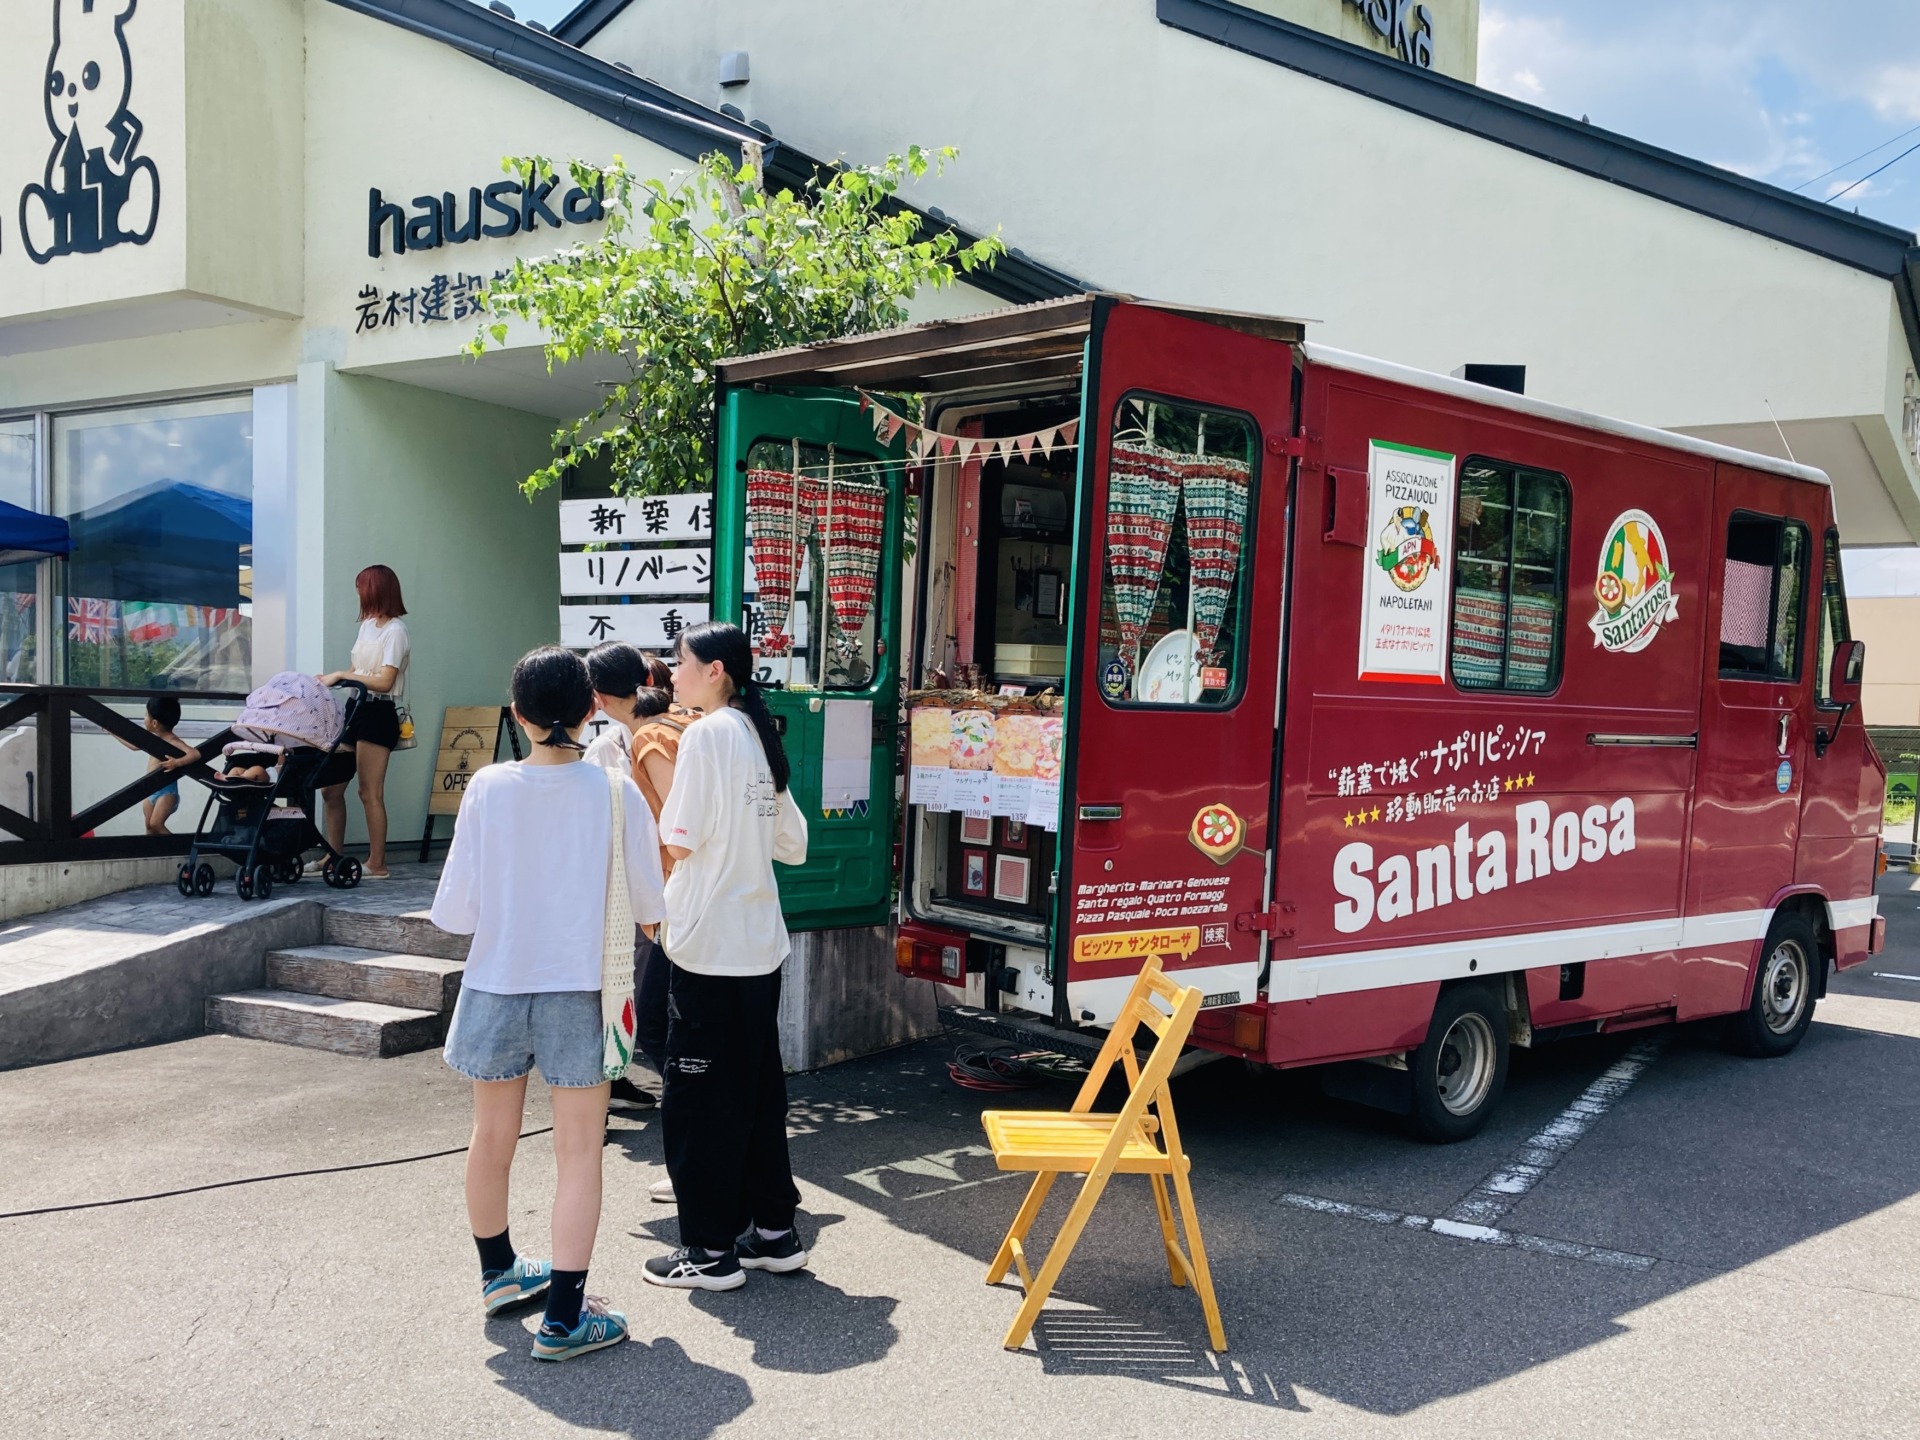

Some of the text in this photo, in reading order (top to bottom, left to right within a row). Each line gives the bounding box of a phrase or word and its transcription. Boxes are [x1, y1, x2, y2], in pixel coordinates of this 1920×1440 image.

[356, 267, 512, 334] 岩村建設
[1385, 469, 1439, 489] ASSOCIAZIONE
[1385, 483, 1438, 505] PIZZAIUOLI
[1401, 540, 1418, 556] APN
[1379, 595, 1433, 612] NAPOLETANI
[1601, 583, 1668, 648] santarosa
[443, 772, 475, 791] OPE
[1385, 775, 1500, 823] 移動販売のお店
[1333, 796, 1636, 934] Santa Rosa
[1076, 898, 1109, 910] Santa
[1183, 889, 1225, 902] Formaggi
[1076, 913, 1104, 924] Pizza
[1180, 902, 1229, 915] mozzarella
[1080, 931, 1192, 957] ピッツァ サンタローザ
[1204, 927, 1226, 944] 検索
